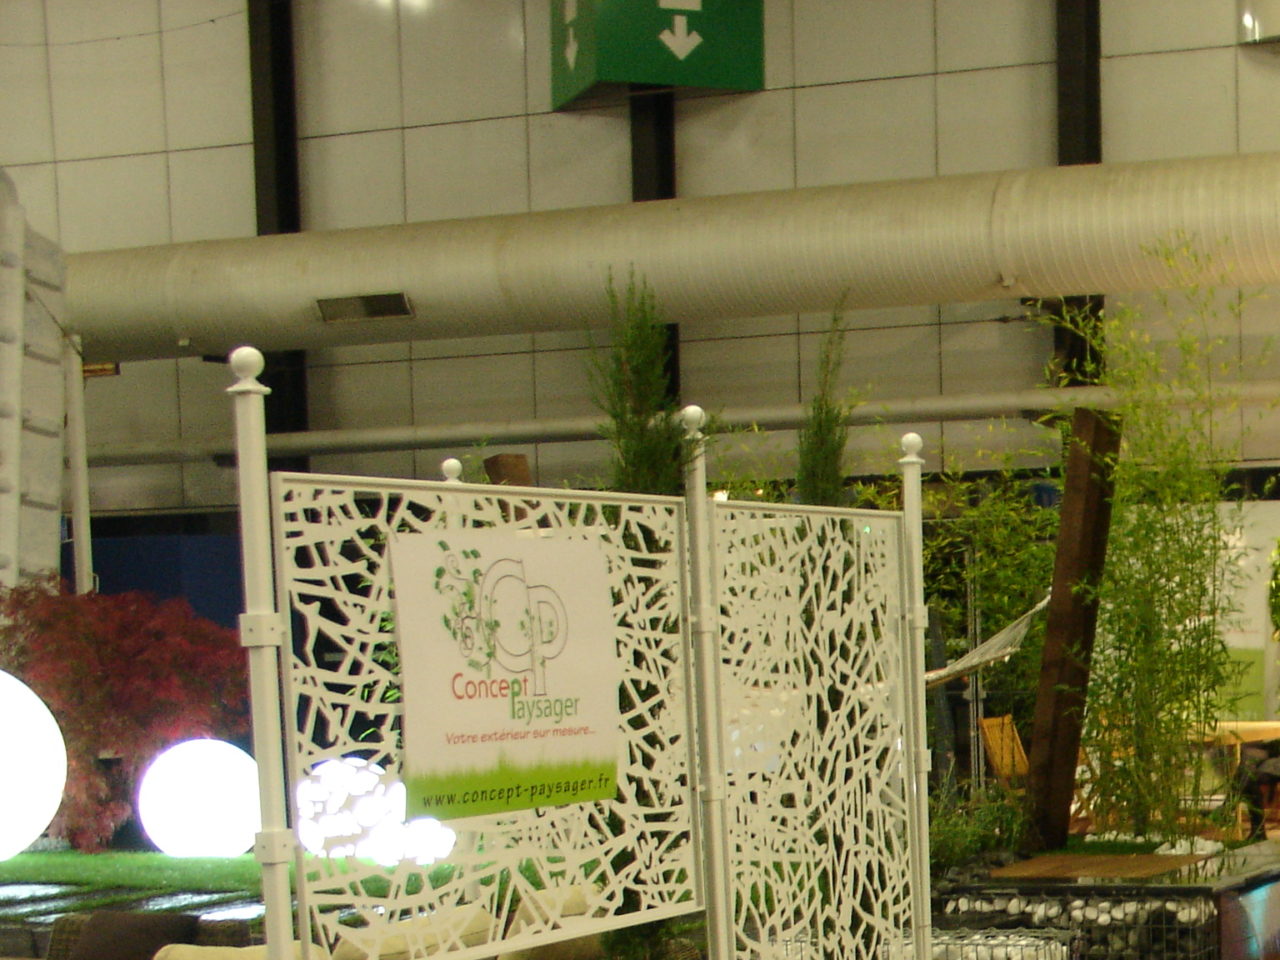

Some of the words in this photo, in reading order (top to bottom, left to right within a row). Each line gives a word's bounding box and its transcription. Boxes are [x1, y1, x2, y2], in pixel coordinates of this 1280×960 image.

[452, 672, 529, 700] Concept
[511, 678, 581, 726] Paysager
[446, 732, 478, 745] Votre
[480, 728, 531, 743] extérieur
[533, 729, 551, 740] sur
[422, 772, 611, 809] www.concept-paysager.fr
